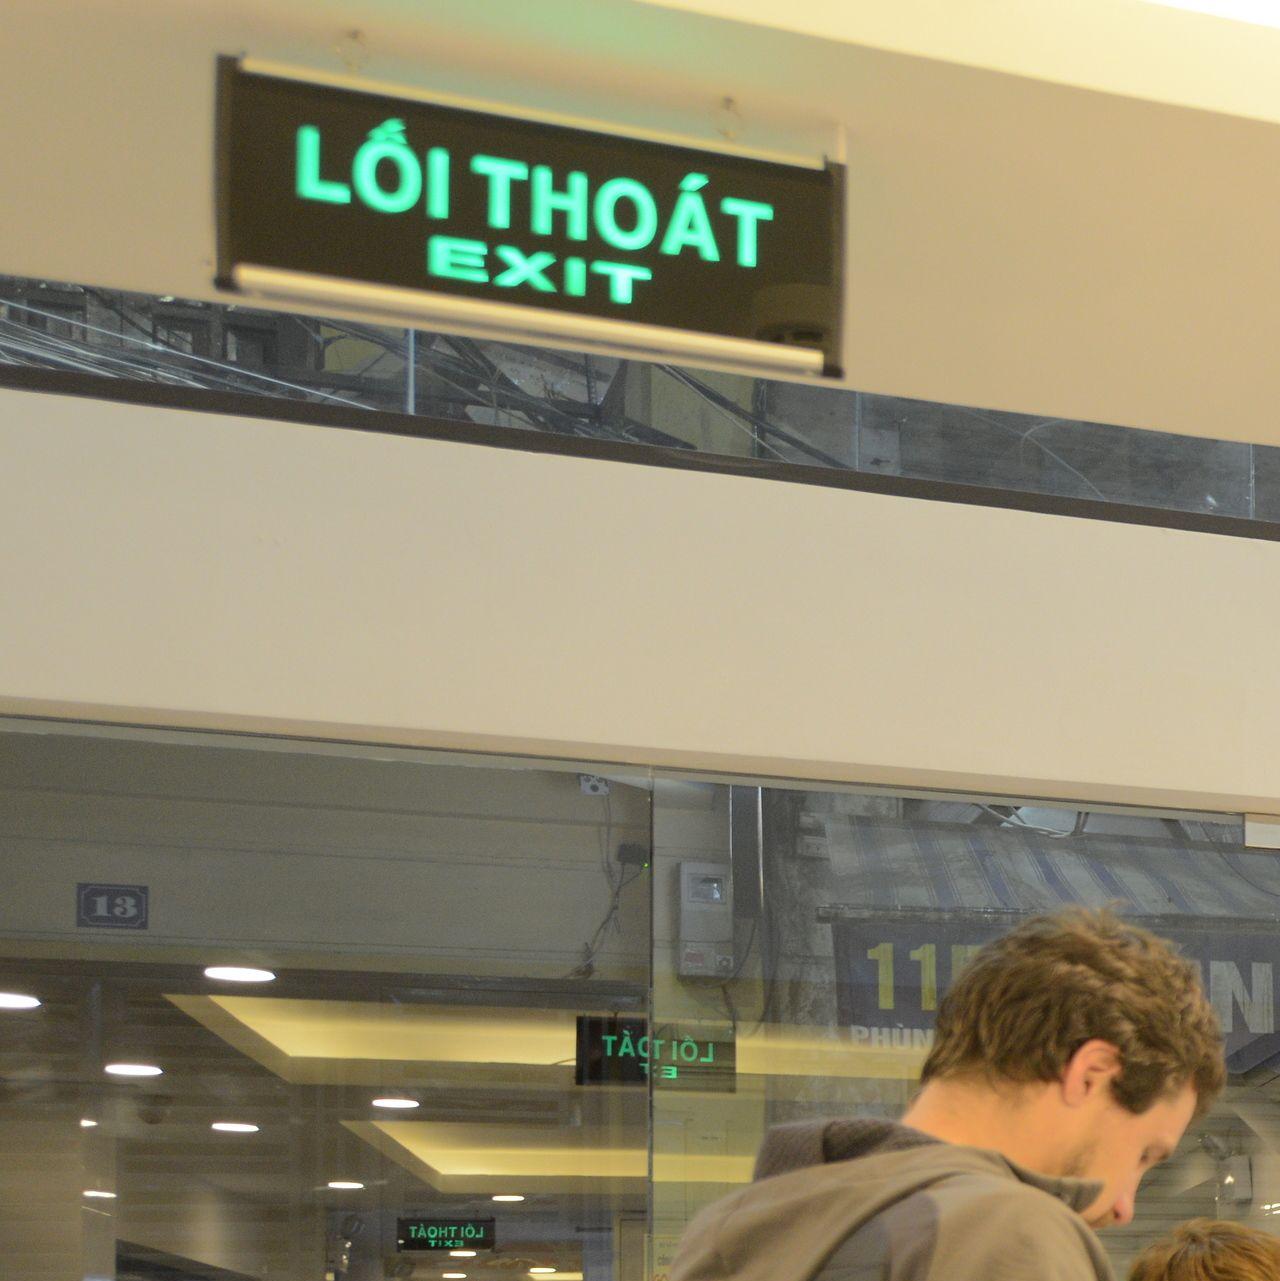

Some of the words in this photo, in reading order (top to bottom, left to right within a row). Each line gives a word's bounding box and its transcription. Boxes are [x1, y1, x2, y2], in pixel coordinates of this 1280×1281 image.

[296, 117, 450, 219] LỐI
[470, 154, 774, 268] THOÁT
[427, 235, 652, 304] EXIT
[89, 895, 138, 918] 13
